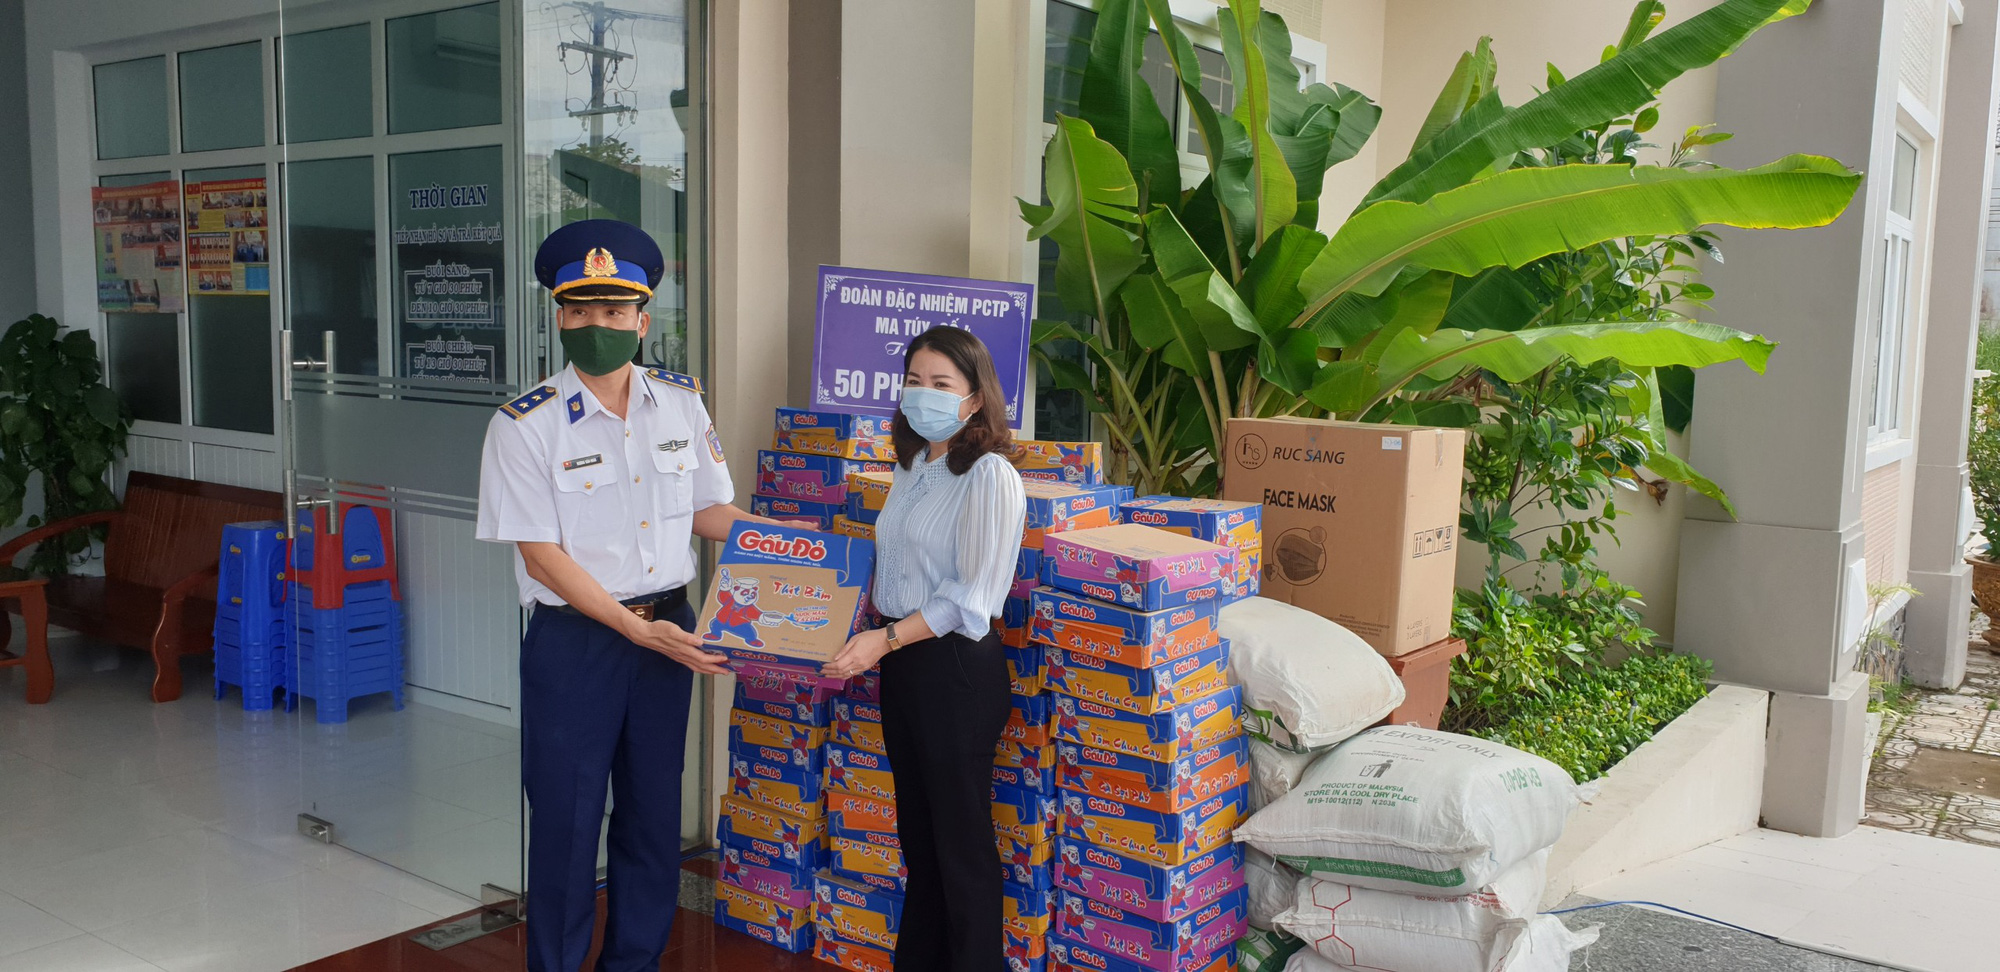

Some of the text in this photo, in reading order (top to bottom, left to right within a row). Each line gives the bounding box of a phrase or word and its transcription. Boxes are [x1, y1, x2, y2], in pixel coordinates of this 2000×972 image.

[409, 182, 488, 209] THỜI GIAN
[425, 259, 445, 277] BUỔI
[414, 278, 483, 295] TỪ 7 GIỜ 30 PHÚT
[410, 296, 488, 314] ĐẾN 10 GIỜ 30 PHÚT
[840, 285, 1010, 318] ĐOÀN ĐẶC NHIỆM PCTP
[875, 316, 899, 336] MA
[425, 335, 445, 353] BUỔI
[452, 358, 463, 370] 30
[463, 355, 487, 371] PHÚT
[834, 368, 865, 398] 50
[1273, 447, 1345, 465] RUC SANG
[1263, 488, 1337, 513] FACE MASK
[773, 581, 832, 601] Thịt Bằm
[1075, 682, 1143, 712] Tôm Chua Cay
[1090, 731, 1161, 760] Tôm Chua Cay
[1384, 730, 1457, 746] EXPORT
[1456, 743, 1502, 759] ONLY
[1303, 789, 1330, 797] STORE
[1349, 790, 1371, 798] COOL
[1373, 791, 1391, 799] DRY
[1391, 793, 1419, 803] PLACE
[1368, 784, 1404, 792] MALAYSIA
[1097, 830, 1168, 860] Tôm Chua Cay
[1099, 880, 1147, 909] Thịt Bằm
[1102, 931, 1151, 961] Thịt Bằm
